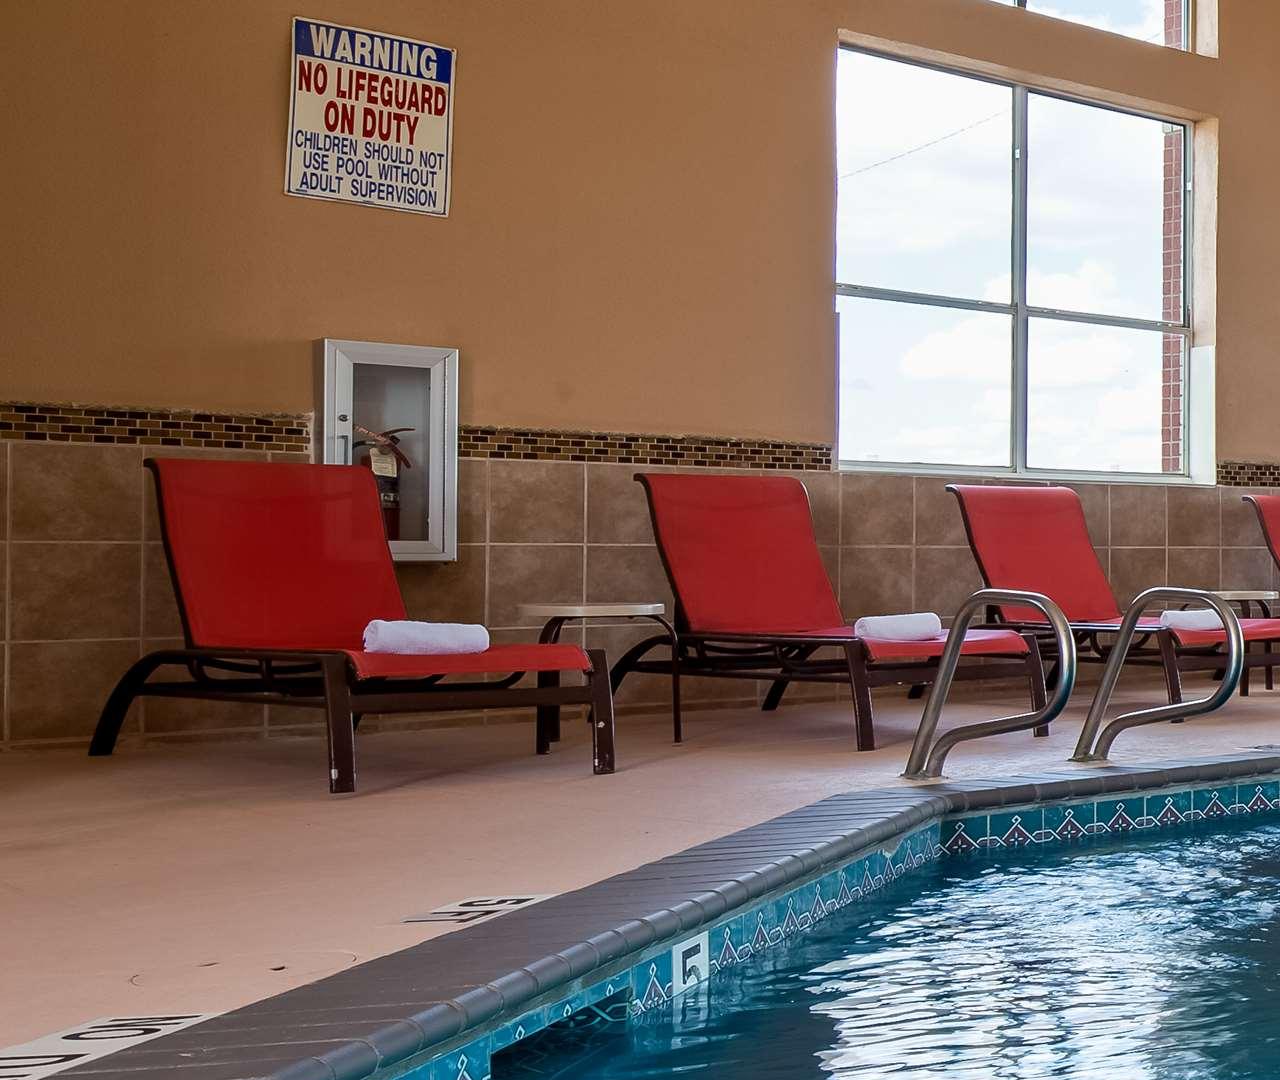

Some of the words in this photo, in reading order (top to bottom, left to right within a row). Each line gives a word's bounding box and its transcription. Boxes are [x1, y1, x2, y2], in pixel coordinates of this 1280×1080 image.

[309, 24, 438, 79] WARNING
[298, 60, 328, 95] NO
[336, 67, 446, 117] LIFEGUARD
[324, 100, 355, 135] ON
[362, 110, 419, 145] DUTY
[295, 130, 358, 156] CHILDREN
[364, 141, 414, 165] SHOULD
[419, 151, 445, 170] NOT
[303, 151, 329, 172] USE
[336, 156, 372, 179] POOL
[378, 163, 437, 188] WITHOUT
[300, 171, 343, 194] ADULT
[350, 179, 437, 208] SUPERVISION
[681, 942, 702, 986] 5
[61, 1014, 204, 1041] NO
